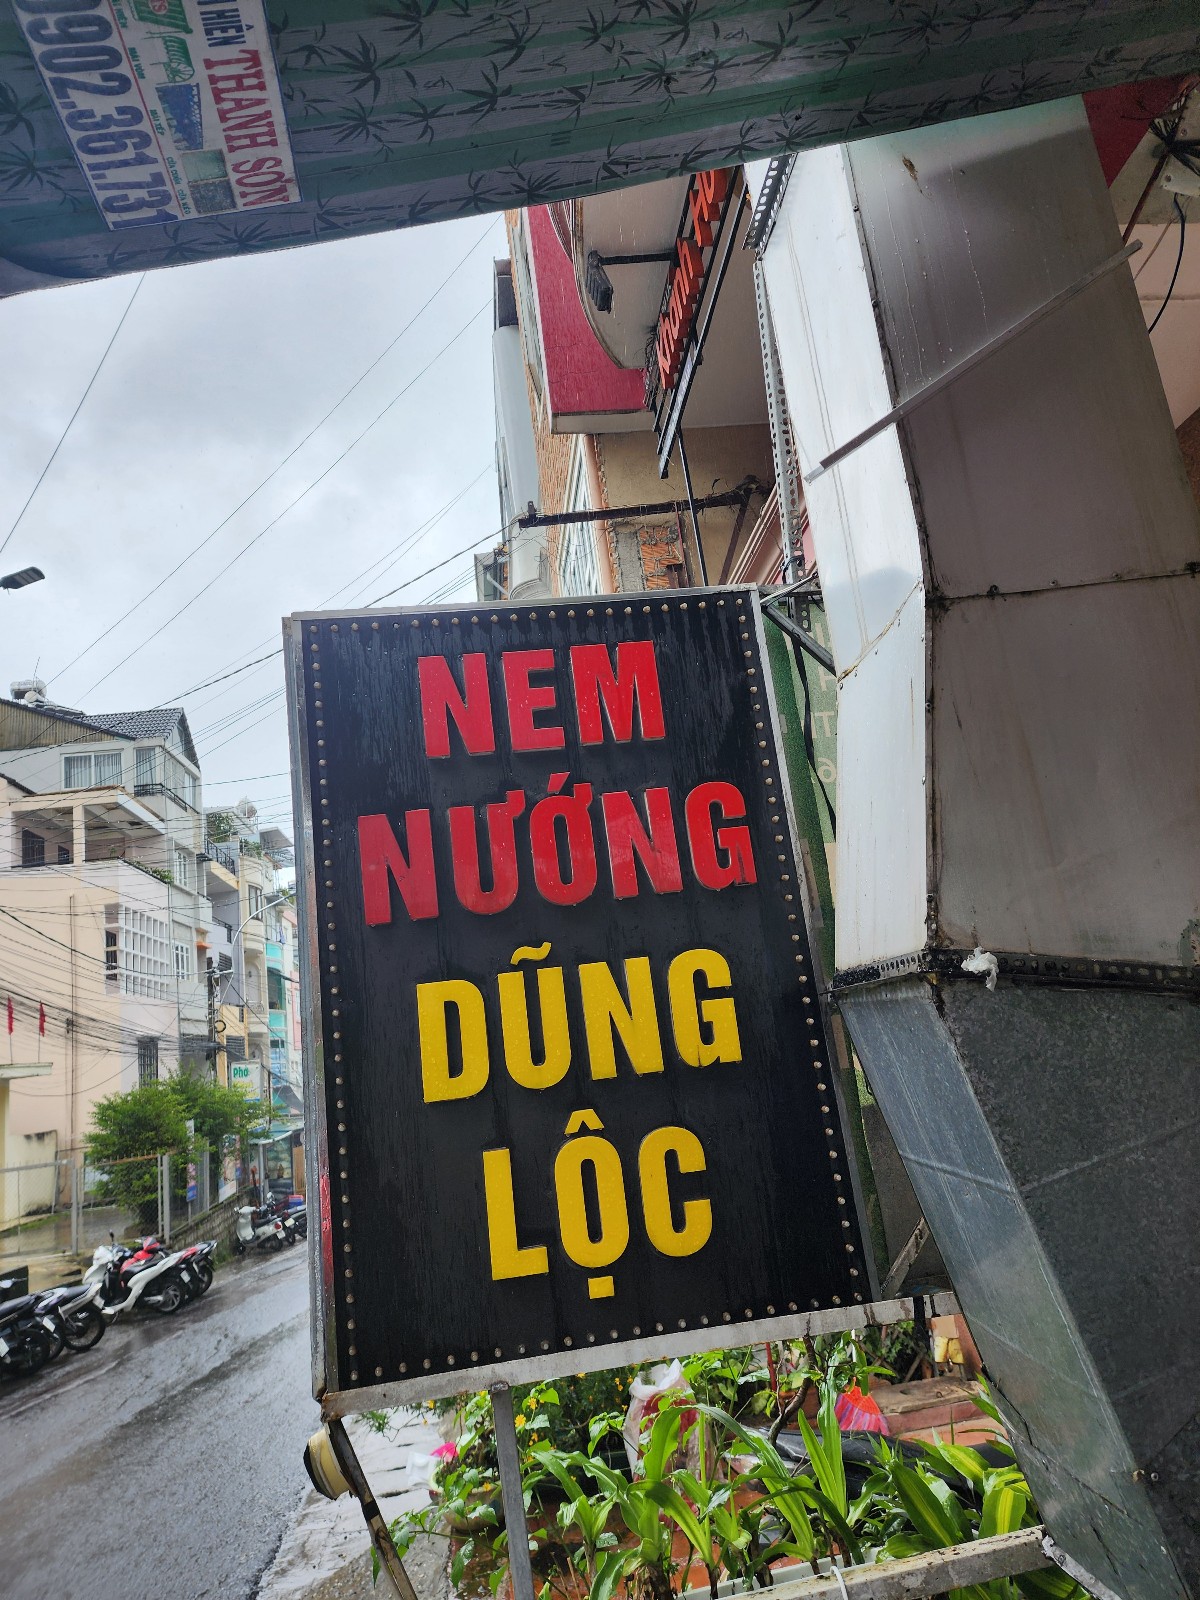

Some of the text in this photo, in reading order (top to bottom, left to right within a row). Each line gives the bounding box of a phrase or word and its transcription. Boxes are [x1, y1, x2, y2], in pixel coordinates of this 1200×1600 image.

[199, 8, 256, 47] HIÊN
[202, 49, 279, 153] THANH
[230, 155, 294, 208] SƠN
[418, 641, 667, 759] NEM
[358, 772, 758, 926] NƯỚNG
[415, 942, 742, 1104] DŨNG
[482, 1109, 713, 1300] LỘC
